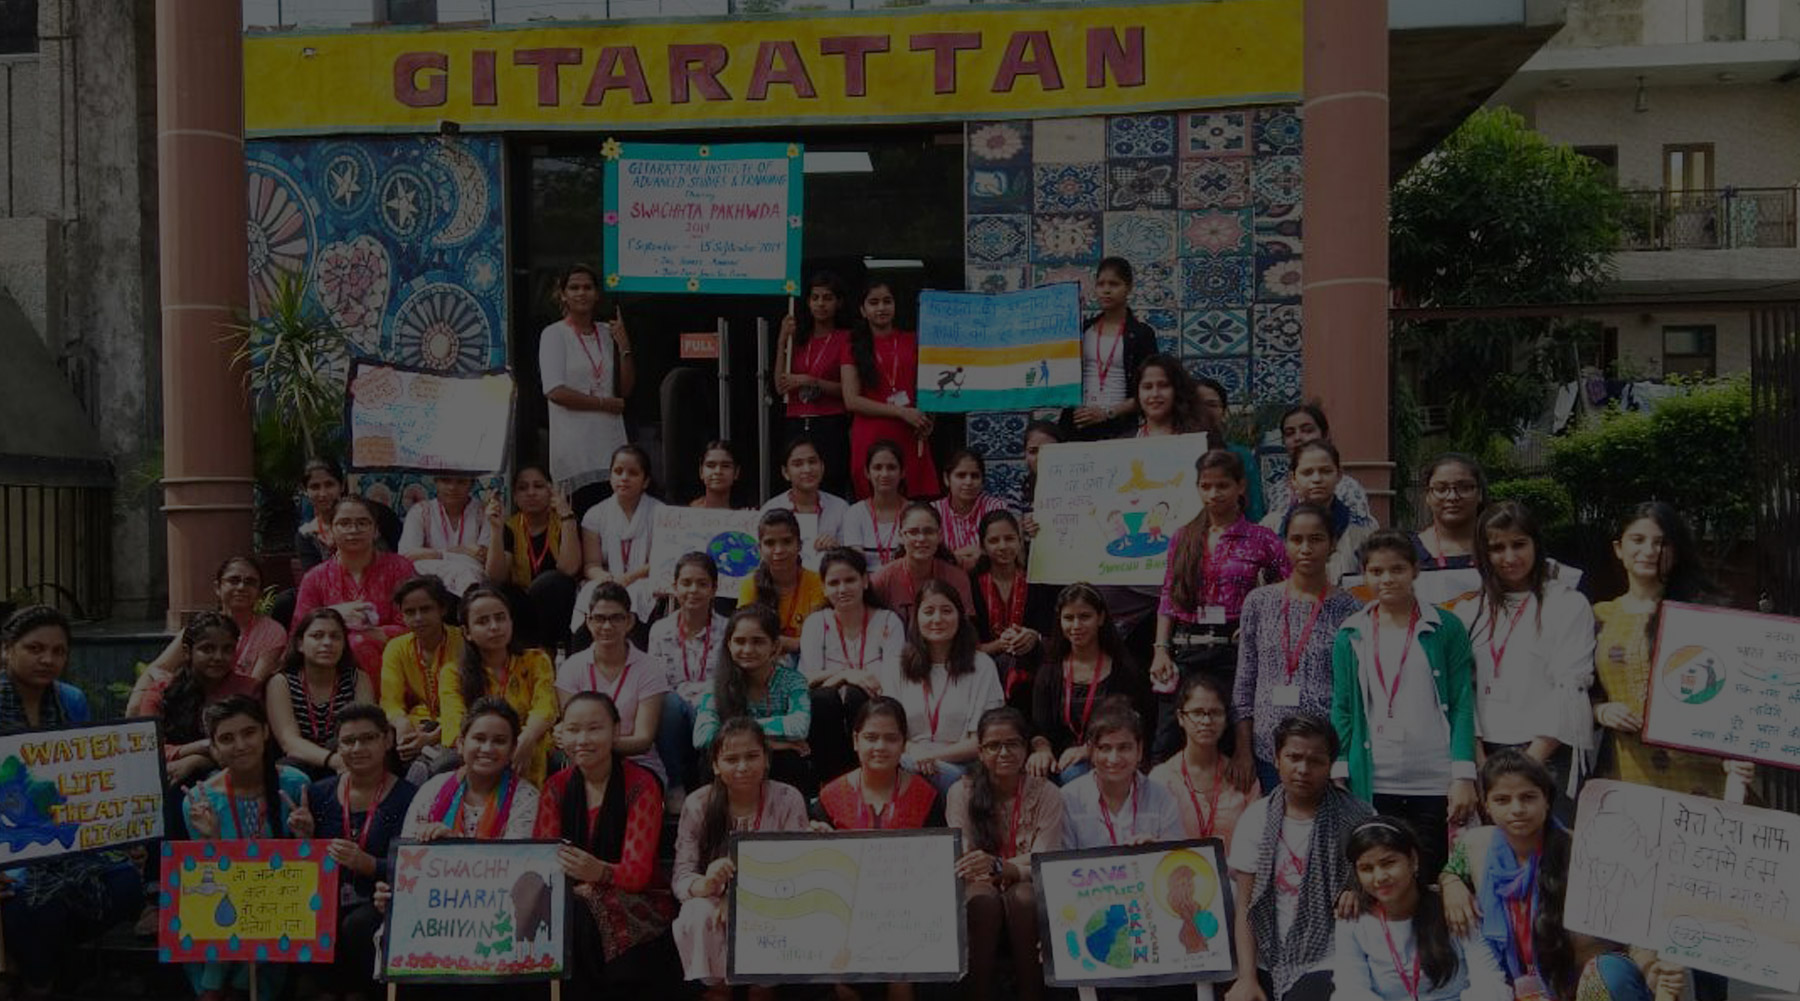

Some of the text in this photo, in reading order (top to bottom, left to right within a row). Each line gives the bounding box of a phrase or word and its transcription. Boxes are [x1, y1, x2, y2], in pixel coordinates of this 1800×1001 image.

[393, 27, 1147, 109] GITARATTAN
[628, 162, 700, 175] GITARATTAN
[684, 339, 715, 354] PULL
[20, 732, 124, 768] WATER
[57, 769, 116, 796] LIFE
[427, 856, 511, 881] SWACHH
[1067, 865, 1129, 888] SAVE
[428, 887, 511, 912] BHARAT
[411, 918, 496, 940] ABHIYAN
